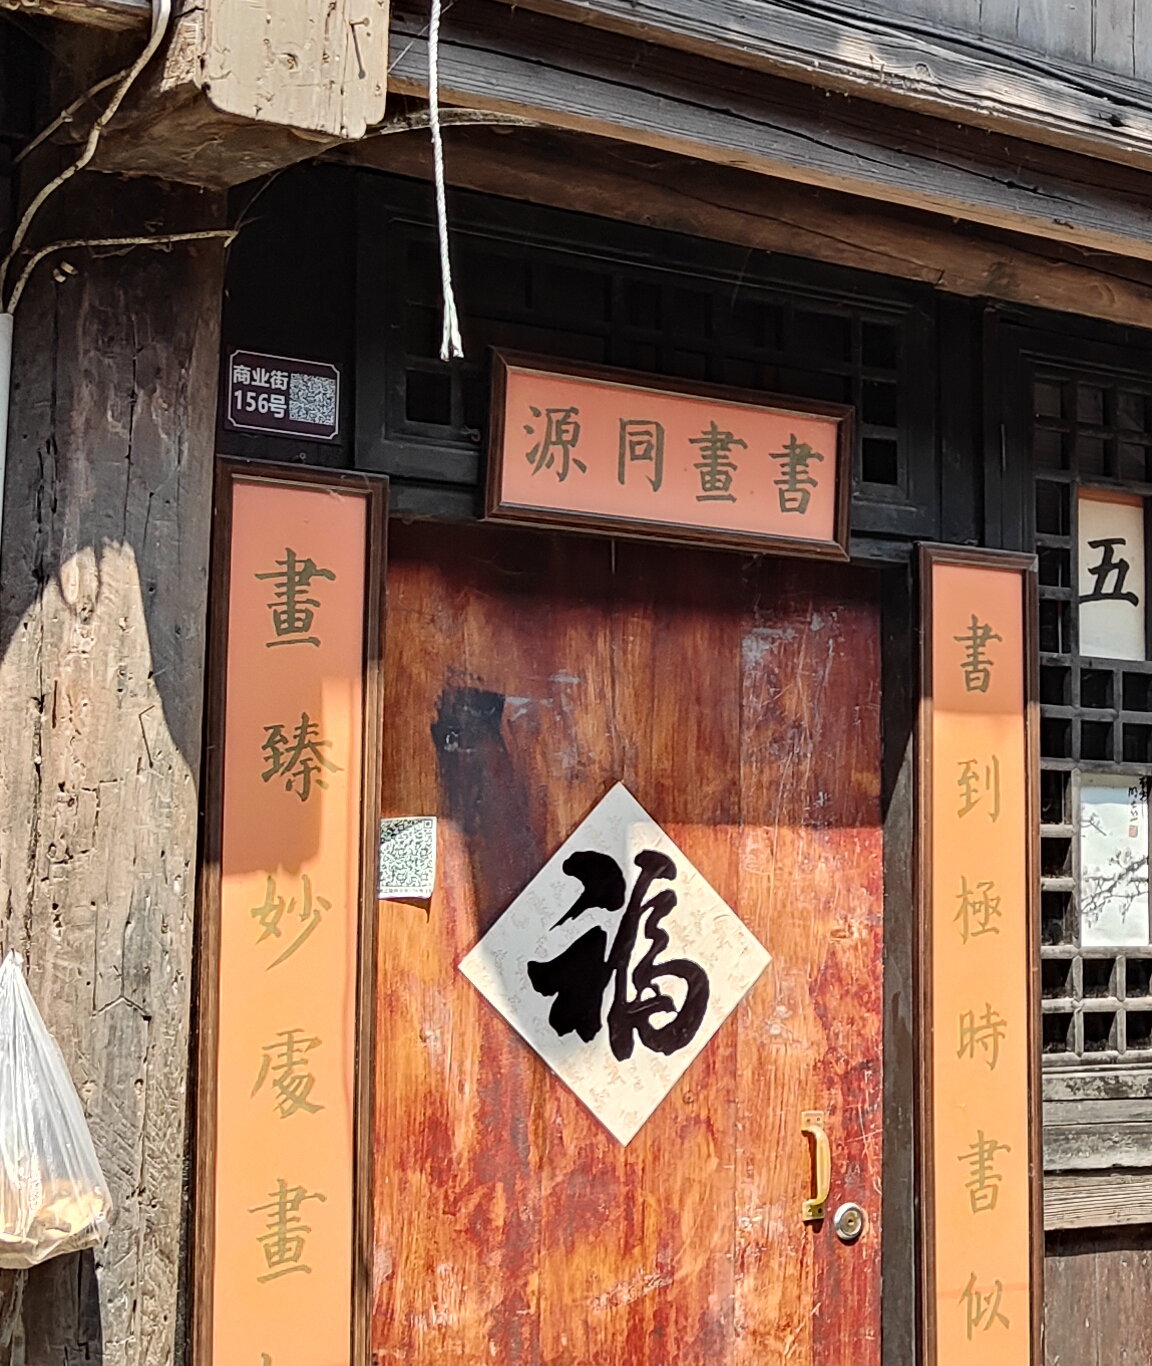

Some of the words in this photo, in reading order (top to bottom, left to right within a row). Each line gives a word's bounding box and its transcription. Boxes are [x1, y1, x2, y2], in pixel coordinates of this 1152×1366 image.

[233, 364, 289, 391] 商业街
[233, 389, 288, 419] 156号
[527, 848, 711, 1063] 福
